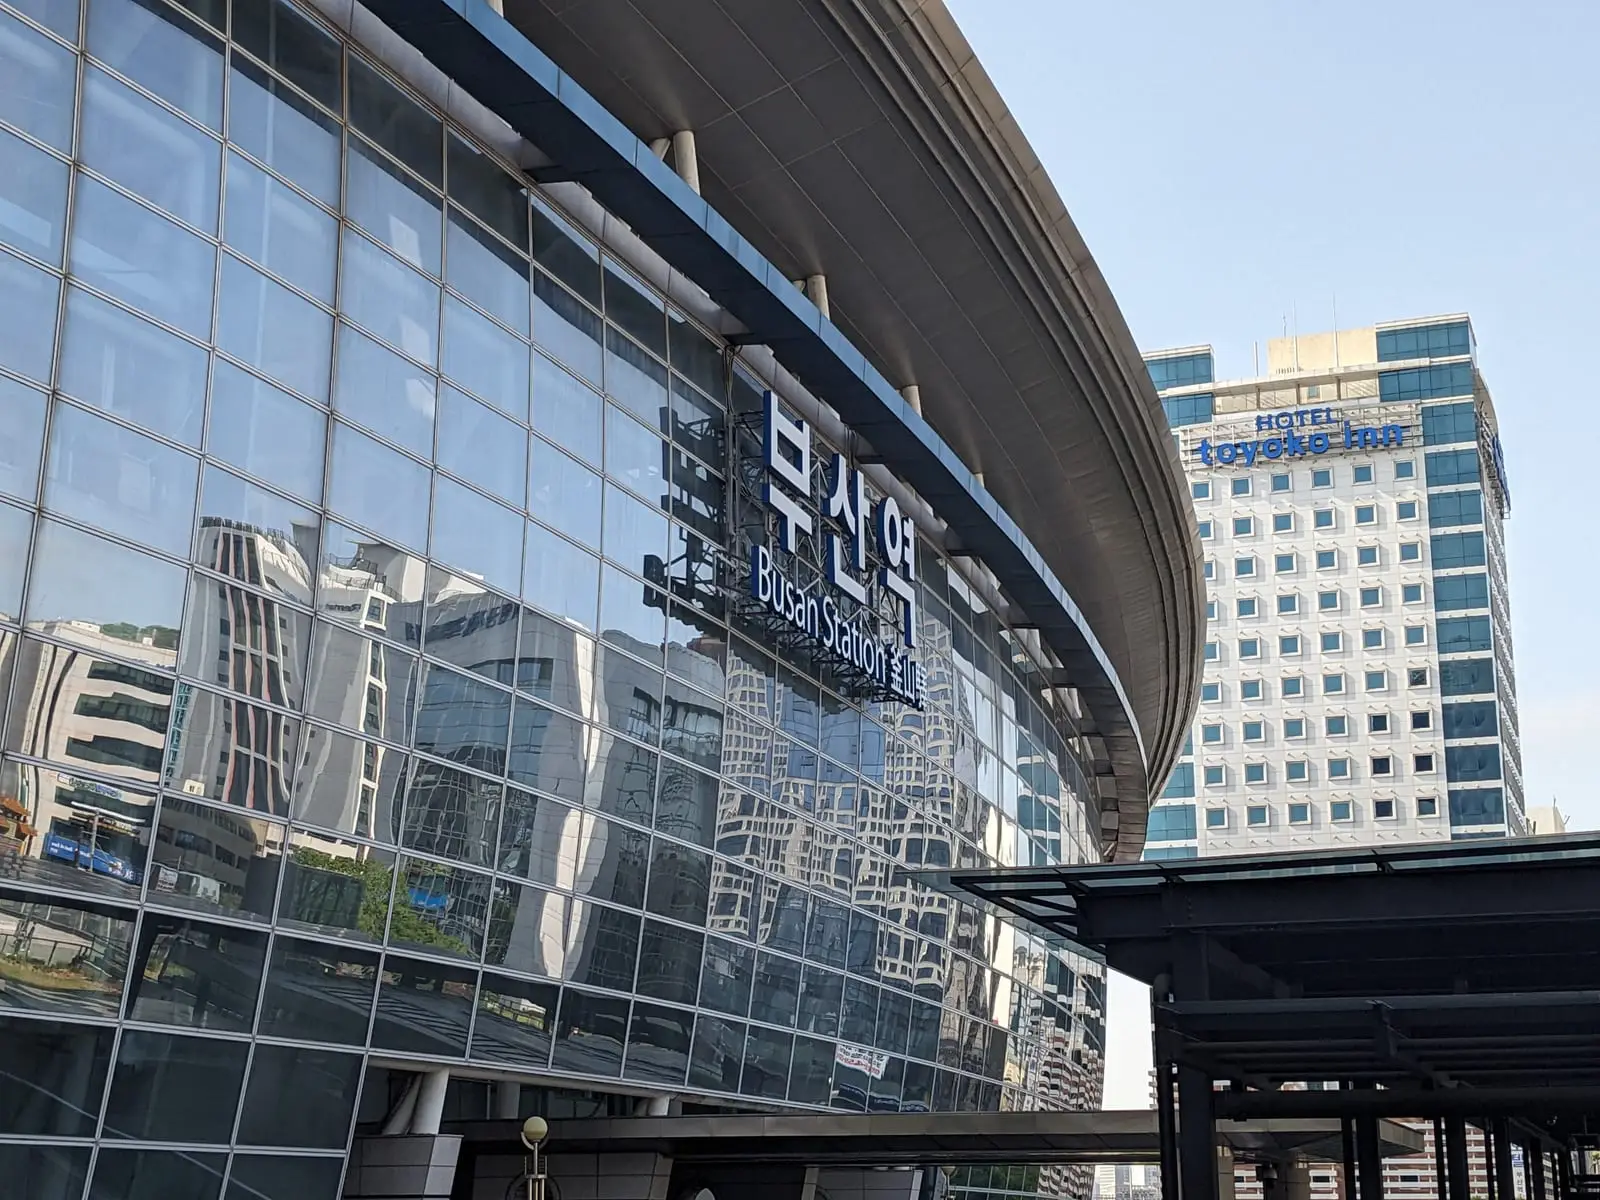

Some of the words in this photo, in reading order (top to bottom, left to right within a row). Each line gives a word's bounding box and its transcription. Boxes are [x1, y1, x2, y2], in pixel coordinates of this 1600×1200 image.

[1200, 428, 1330, 467] toyoko
[1256, 407, 1338, 431] HOTEL
[763, 390, 916, 648] 부산역
[754, 545, 819, 640] Busan
[819, 596, 886, 686] Station
